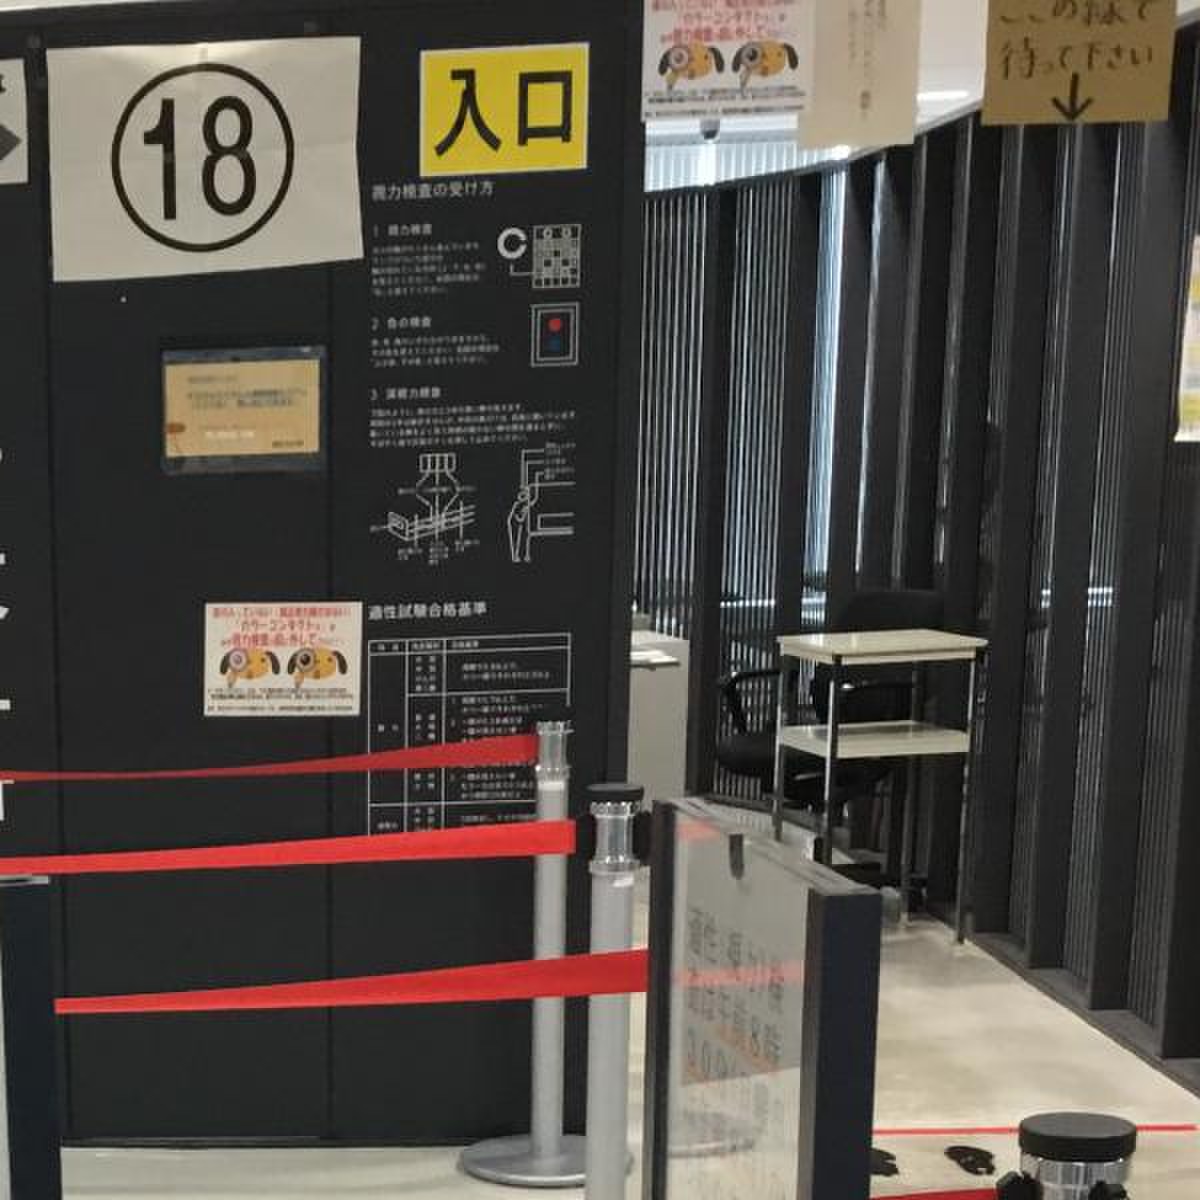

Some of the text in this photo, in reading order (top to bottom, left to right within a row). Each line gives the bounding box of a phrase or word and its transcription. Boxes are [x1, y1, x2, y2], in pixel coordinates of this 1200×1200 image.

[999, 37, 1153, 79] 待って下さい
[434, 68, 574, 157] 入口
